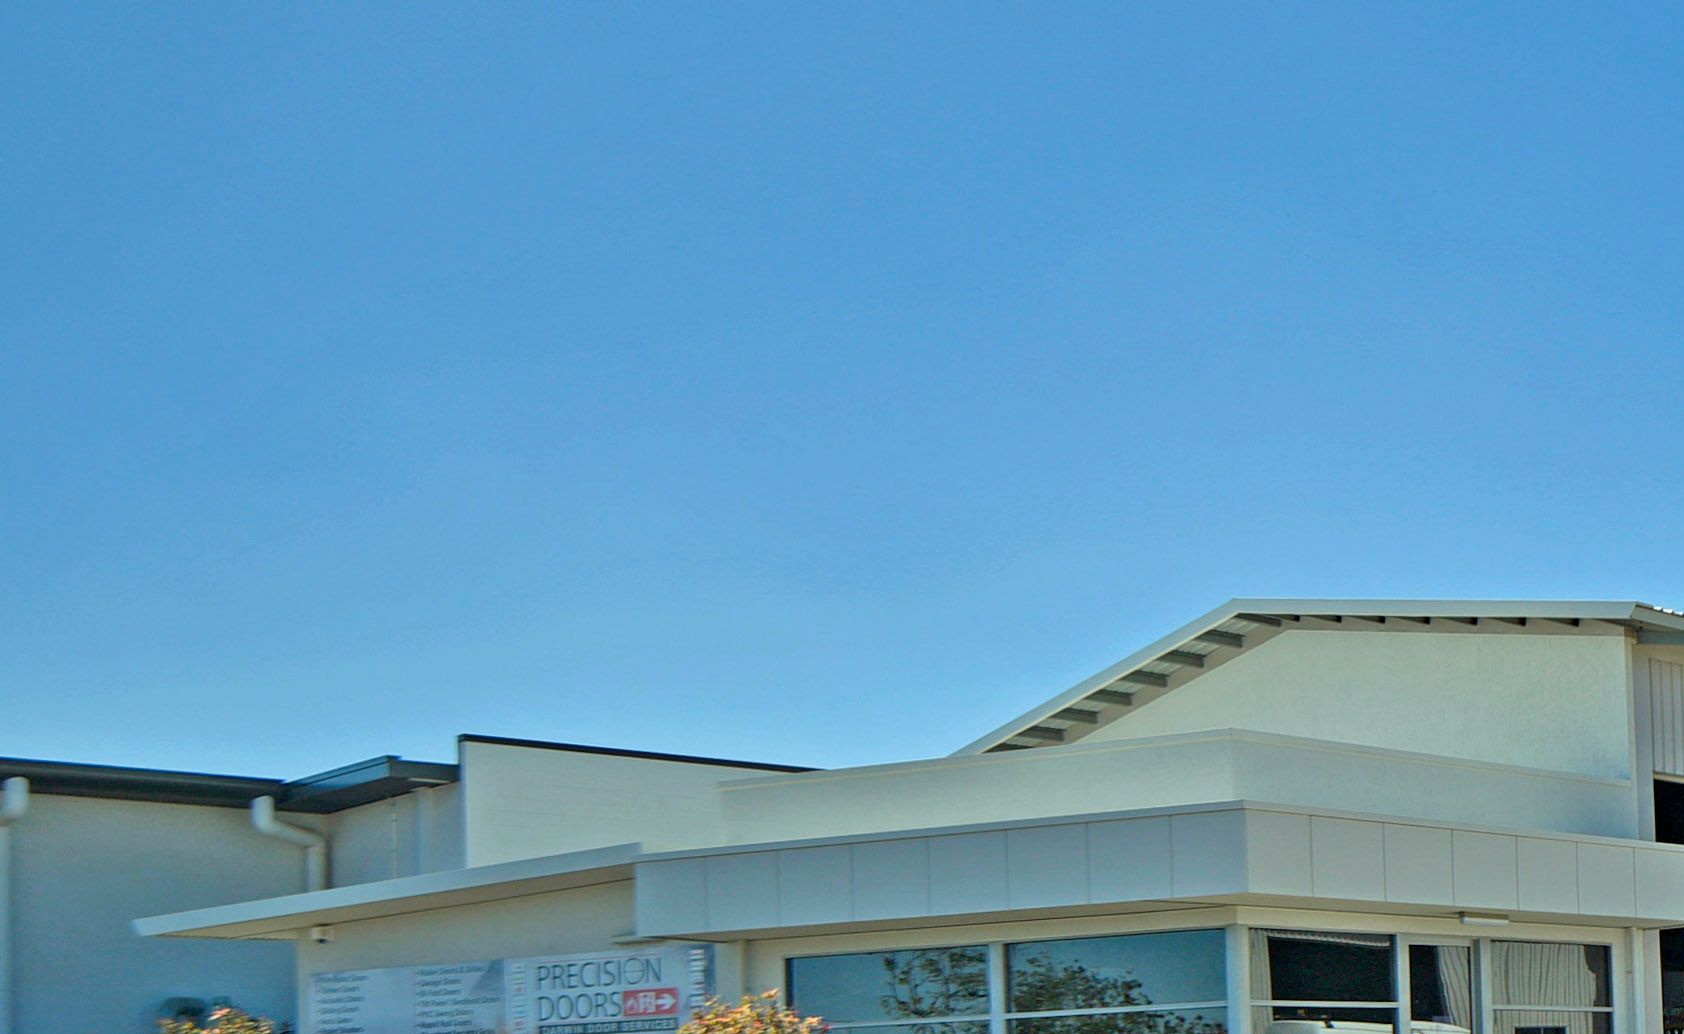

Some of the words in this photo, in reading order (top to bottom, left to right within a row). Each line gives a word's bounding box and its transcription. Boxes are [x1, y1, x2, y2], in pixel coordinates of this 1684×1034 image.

[537, 957, 662, 990] PRECISION
[538, 991, 623, 1021] DOORS
[588, 1022, 618, 1034] DOOR
[622, 1019, 677, 1032] SERVICES
